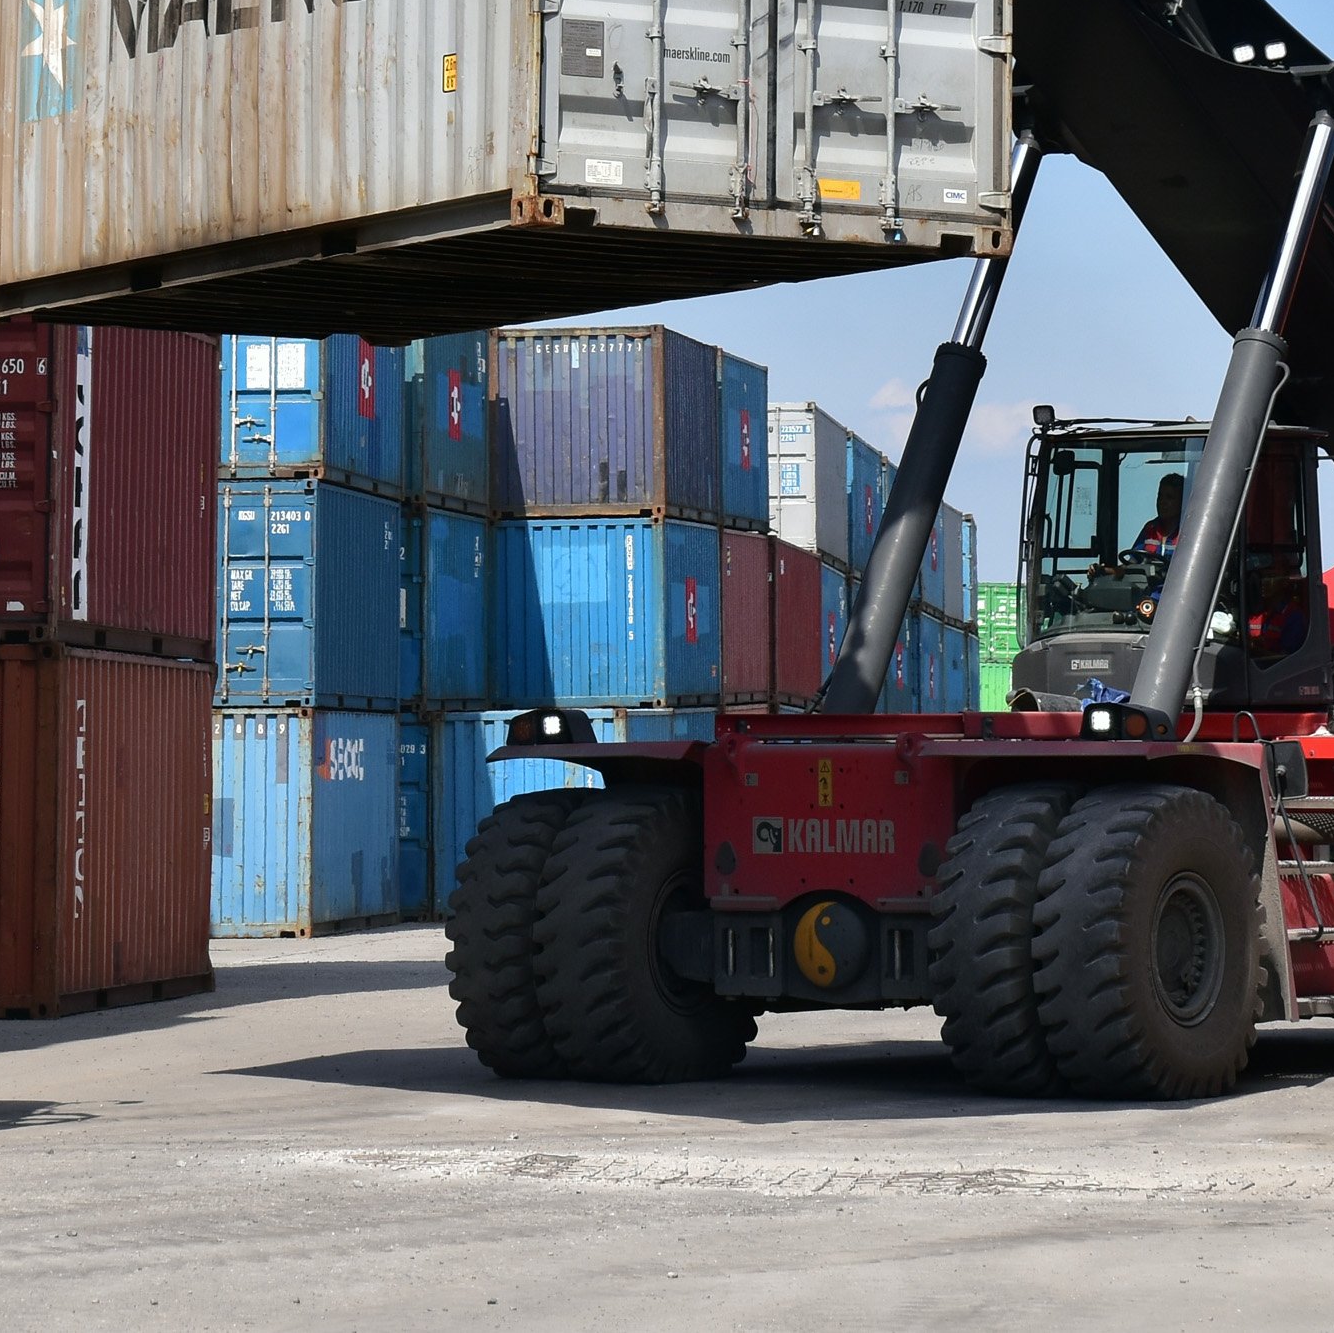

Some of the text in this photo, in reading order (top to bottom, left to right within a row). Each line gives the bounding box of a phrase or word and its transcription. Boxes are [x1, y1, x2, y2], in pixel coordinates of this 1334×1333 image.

[899, 0, 924, 13] 1.170
[38, 359, 45, 373] 6
[270, 511, 301, 521] 213403
[272, 524, 289, 534] 22G1
[788, 819, 895, 854] KALMAR
